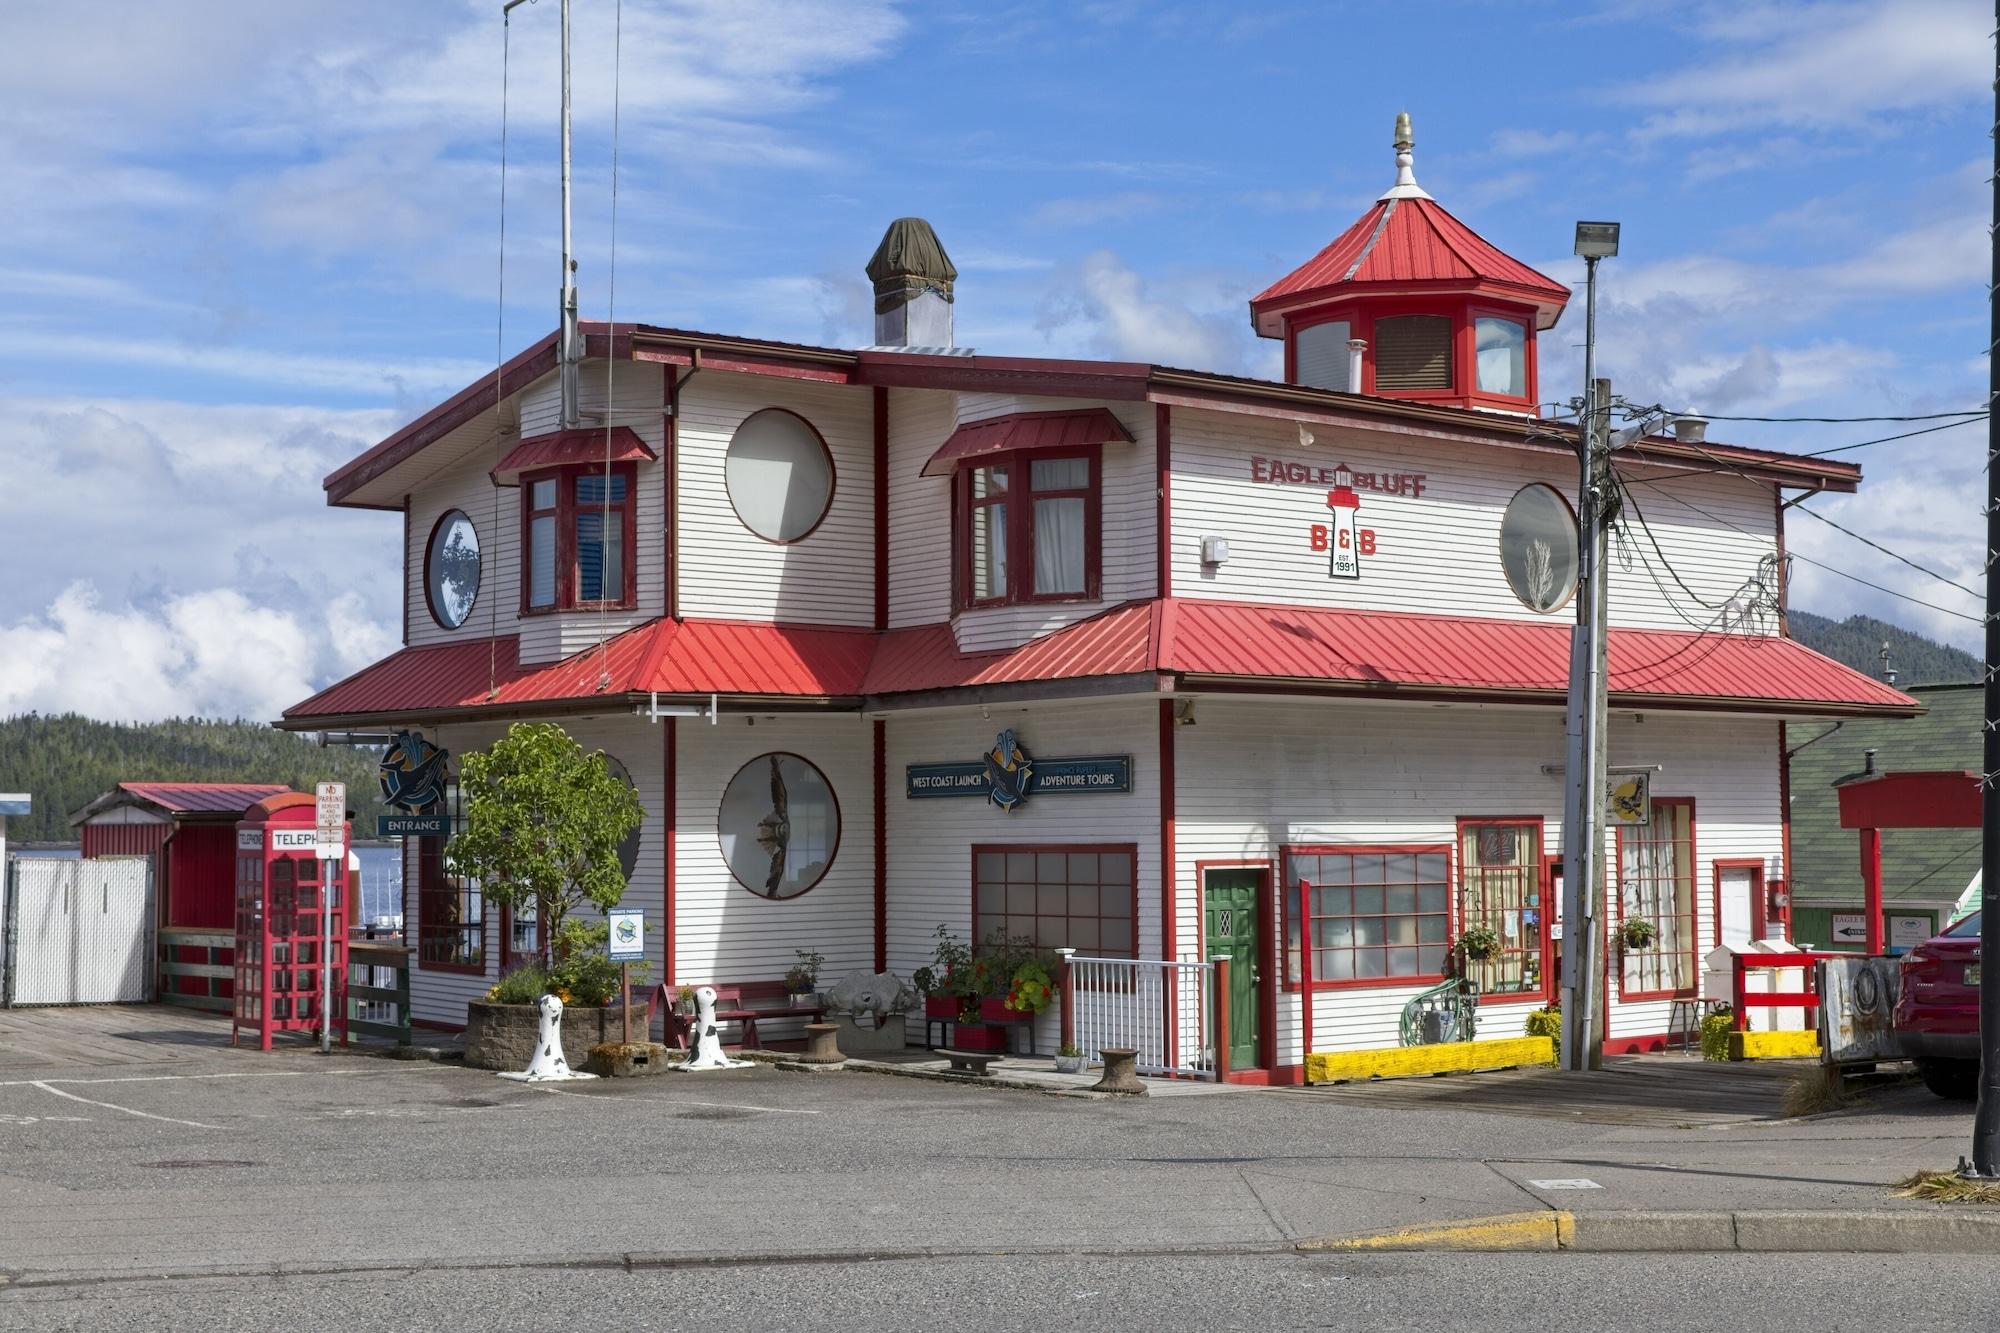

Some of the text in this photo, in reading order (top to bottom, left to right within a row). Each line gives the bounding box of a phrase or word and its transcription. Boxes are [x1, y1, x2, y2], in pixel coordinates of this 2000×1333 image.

[1251, 455, 1427, 498] EAGLE BLUFF
[1310, 524, 1377, 556] B & B
[1335, 562, 1355, 572] 1991
[912, 774, 982, 788] WEST COAST LAUNCH
[1040, 773, 1115, 786] ADVENTURE TOURS
[325, 786, 337, 795] NO
[387, 820, 441, 831] ENTRANCE
[275, 833, 318, 845] TELEPH
